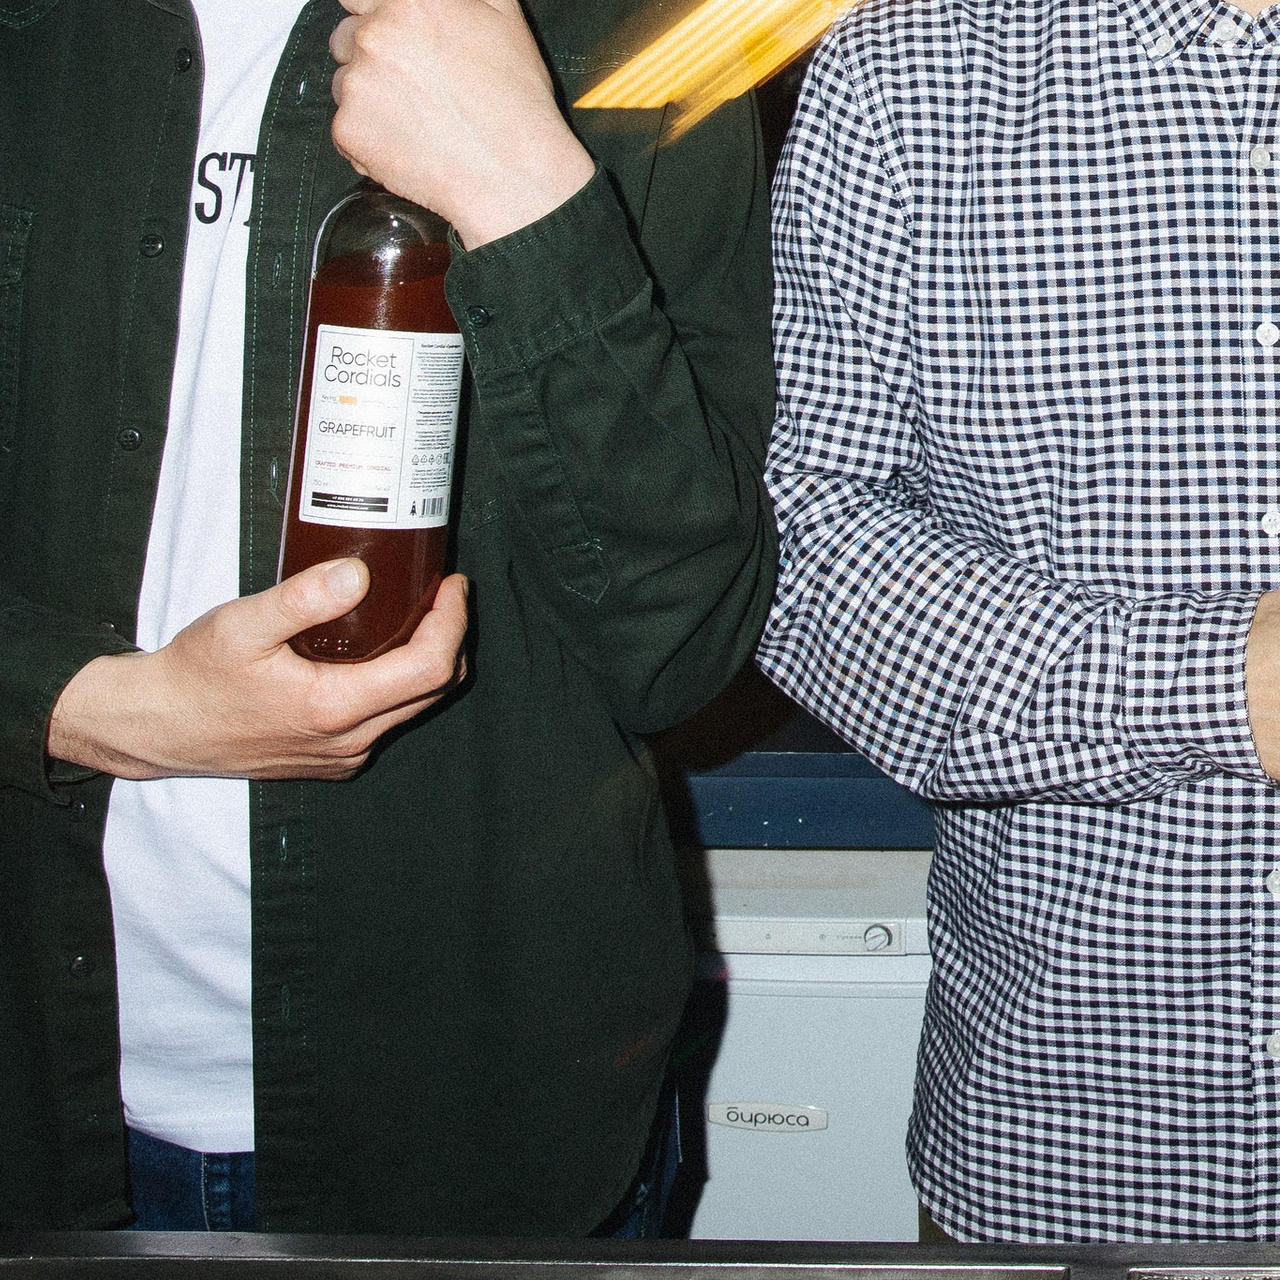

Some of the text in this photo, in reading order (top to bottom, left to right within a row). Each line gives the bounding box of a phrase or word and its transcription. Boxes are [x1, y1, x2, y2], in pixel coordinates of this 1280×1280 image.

[331, 345, 398, 369] Rocket
[324, 364, 402, 388] Cordials
[318, 420, 396, 439] GRAPEFRUIT
[726, 1106, 810, 1128] бирюса
